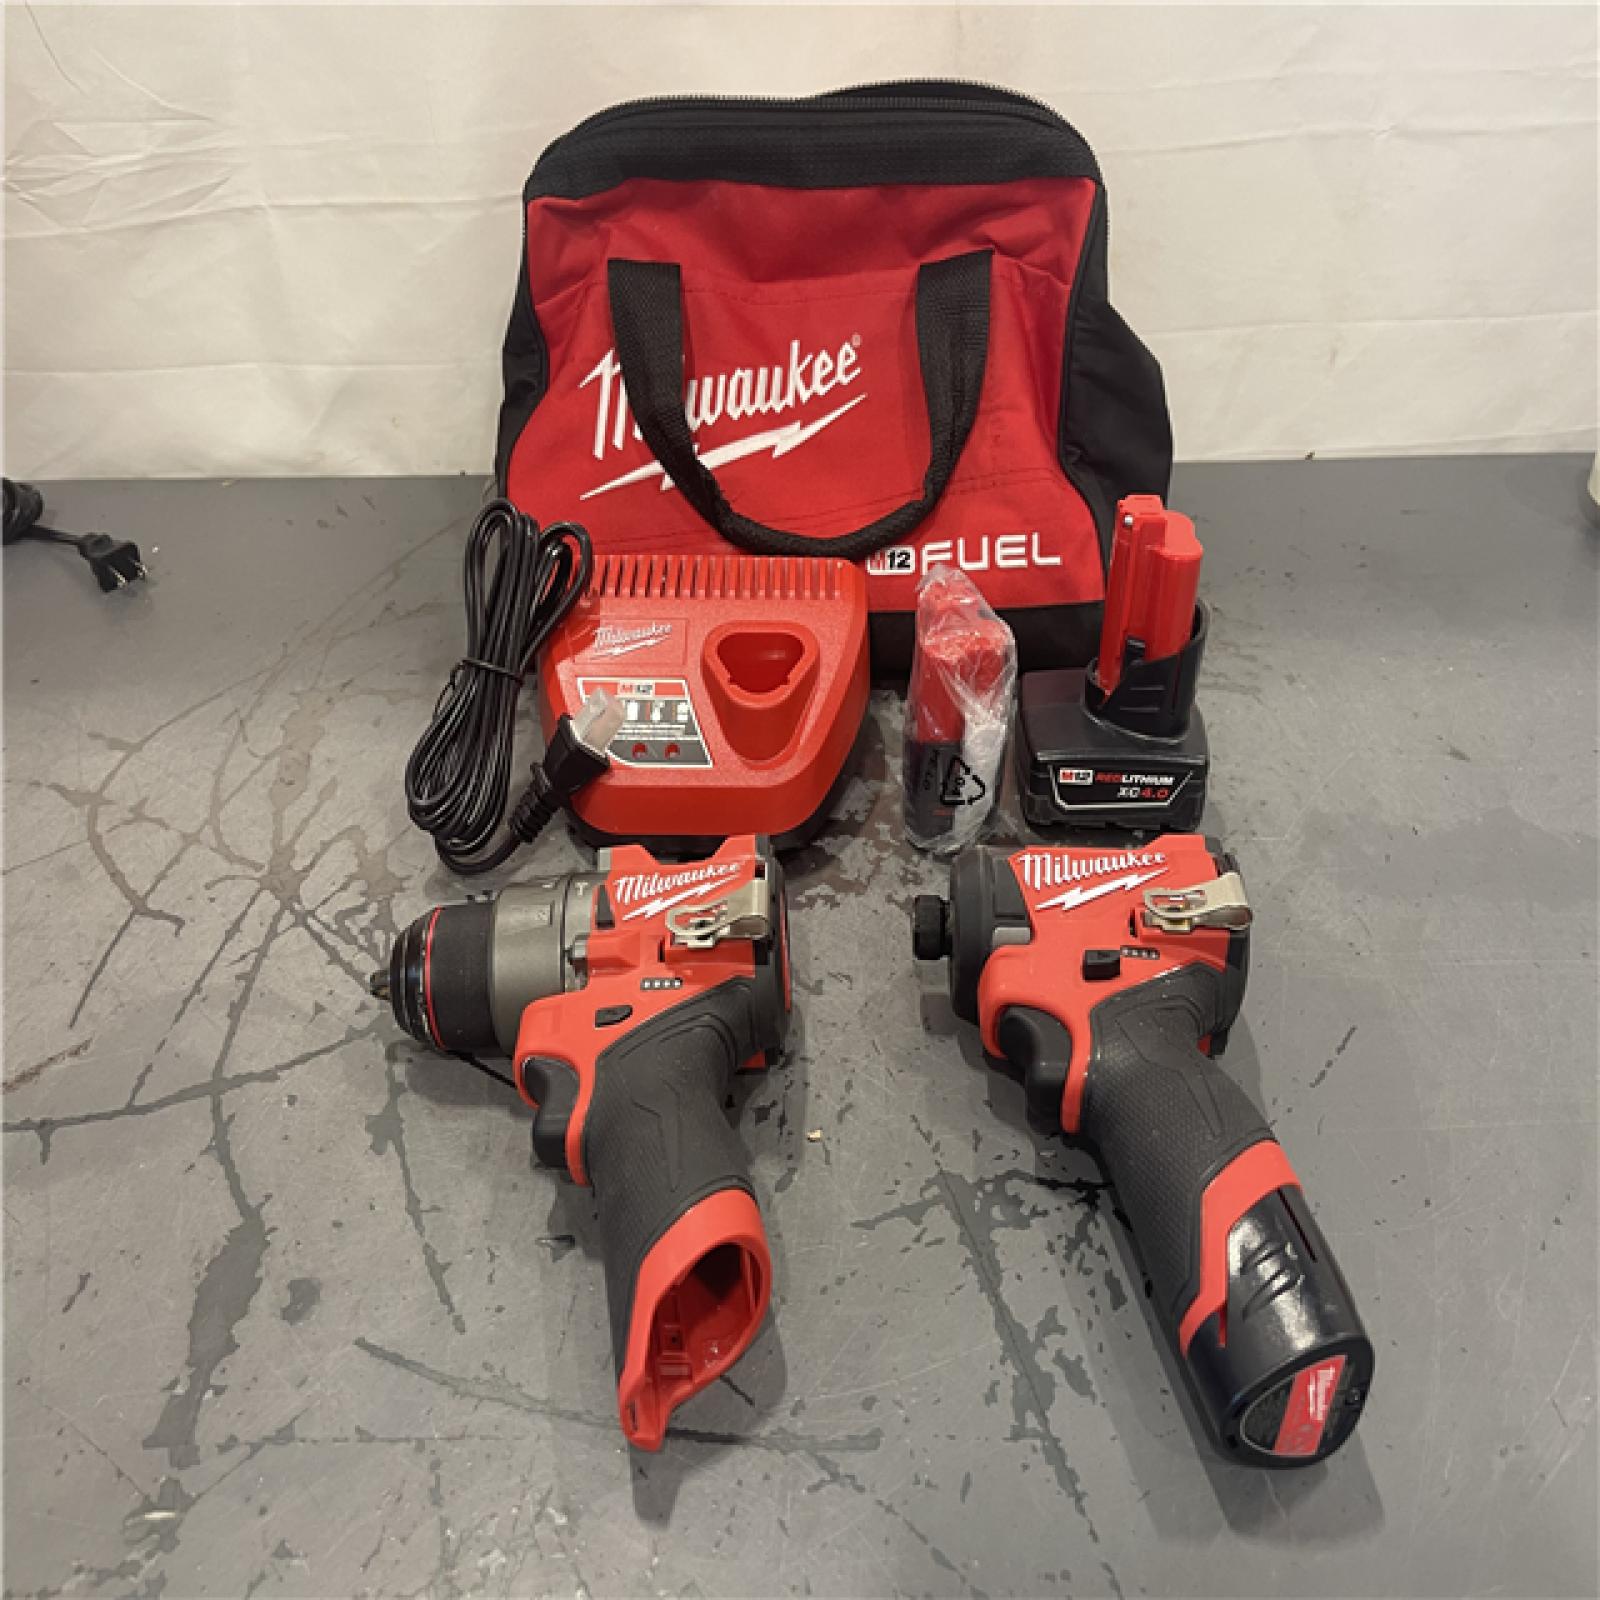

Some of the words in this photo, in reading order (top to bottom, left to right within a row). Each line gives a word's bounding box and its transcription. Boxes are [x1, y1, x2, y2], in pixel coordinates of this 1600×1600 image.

[921, 532, 1062, 576] FUEL
[614, 862, 741, 904] Milwaukee
[1018, 851, 1166, 891] Milwaukee
